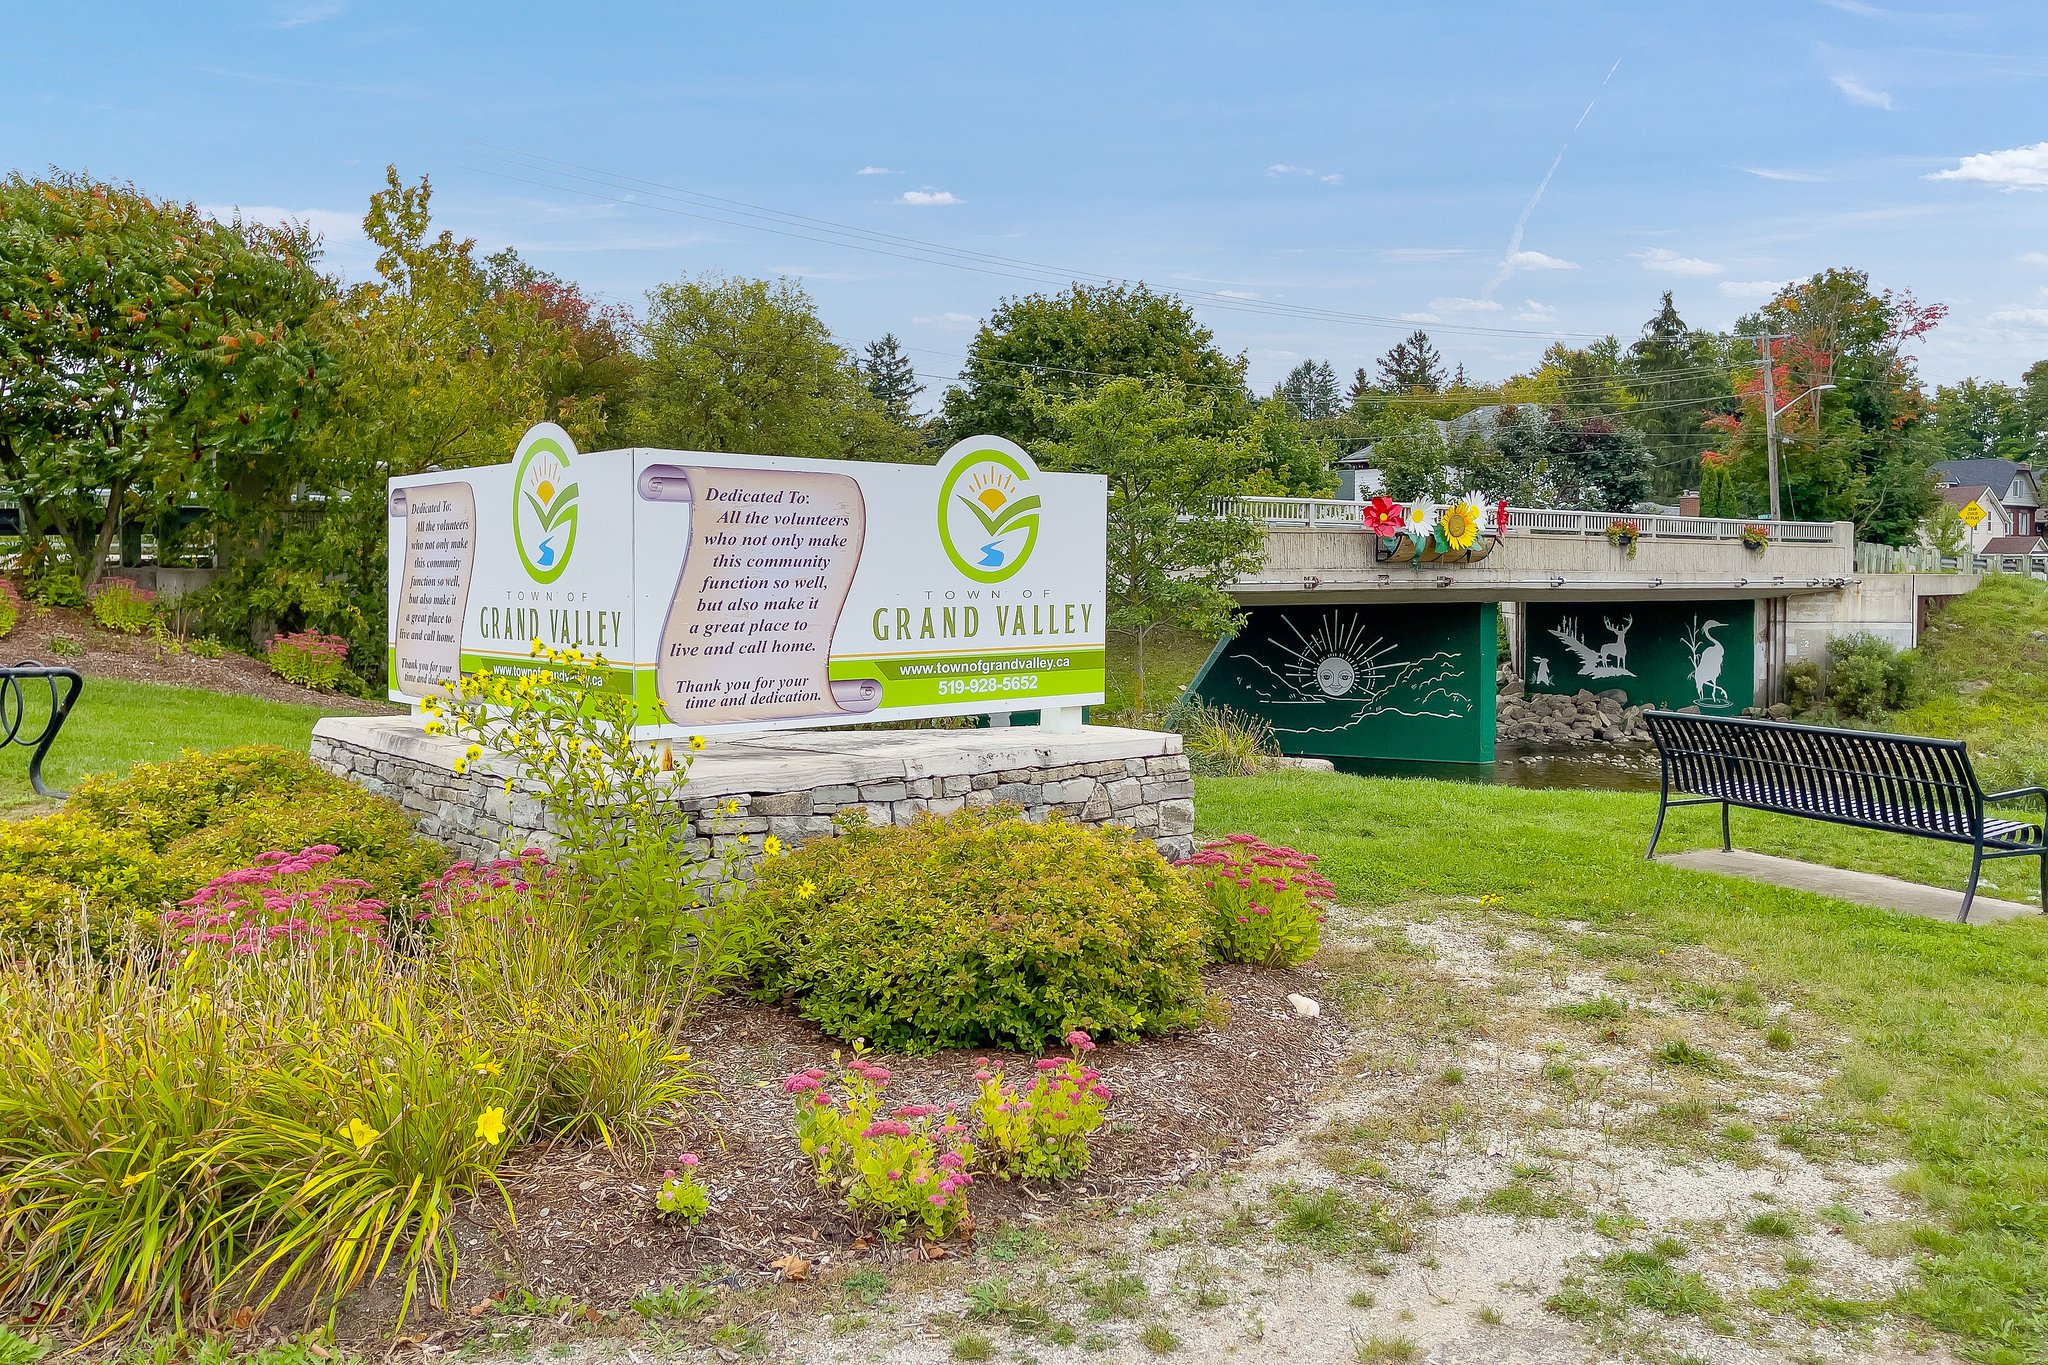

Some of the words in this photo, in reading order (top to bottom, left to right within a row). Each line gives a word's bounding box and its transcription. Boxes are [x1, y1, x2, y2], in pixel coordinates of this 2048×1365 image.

[705, 487, 782, 504] Dedicated
[788, 491, 810, 504] To:
[411, 501, 441, 515] Dedicated
[443, 500, 452, 512] To:
[416, 520, 425, 532] All
[426, 520, 436, 532] the
[437, 519, 469, 531] volunteers
[716, 510, 740, 524] All
[745, 511, 769, 525] the
[774, 512, 850, 527] volunteers
[411, 539, 424, 551] who
[425, 540, 436, 550] not
[436, 538, 450, 552] only
[451, 537, 469, 549] make
[704, 533, 737, 546] who
[742, 535, 767, 547] not
[771, 533, 804, 550] only
[808, 533, 847, 548] make
[414, 557, 425, 568] this
[427, 556, 461, 571] community
[713, 554, 742, 568] this
[746, 555, 831, 571] community
[409, 575, 436, 589] function
[437, 578, 444, 587] so
[446, 575, 460, 588] well,
[699, 576, 769, 593] function
[773, 579, 790, 590] so
[795, 576, 828, 591] well,
[408, 593, 419, 605] but
[420, 593, 432, 605] also
[433, 594, 450, 606] make
[451, 594, 457, 606] it
[506, 591, 553, 601] TOWN
[567, 592, 587, 602] OF
[925, 590, 1000, 600] TOWN
[1022, 589, 1050, 599] OF
[697, 598, 722, 612] but
[727, 597, 759, 611] also
[763, 596, 804, 610] make
[809, 597, 819, 610] it
[405, 614, 410, 622] a
[411, 614, 427, 625] great
[427, 612, 445, 626] place
[445, 614, 452, 624] to
[480, 606, 539, 641] GRAND
[550, 609, 621, 648] VALLEY
[872, 606, 979, 641] GRAND
[996, 604, 1092, 637] VALLEY
[399, 628, 410, 640] live
[411, 629, 423, 641] and
[423, 630, 436, 642] call
[436, 630, 456, 643] home.
[689, 623, 699, 634] a
[703, 621, 745, 637] great
[748, 620, 790, 636] place
[794, 620, 808, 631] to
[670, 643, 699, 657] live
[704, 641, 734, 656] and
[739, 640, 767, 654] call
[772, 640, 816, 653] home.
[1804, 640, 1810, 648] 2
[401, 658, 418, 670] Thank
[418, 662, 429, 673] you
[429, 660, 438, 674] for
[438, 664, 452, 675] your
[900, 657, 1070, 676] www.townofgrandvalley.ca
[404, 672, 416, 683] time
[416, 673, 427, 684] and
[676, 679, 722, 694] Thank
[724, 680, 750, 695] you
[752, 676, 776, 693] for
[777, 676, 809, 692] your
[938, 675, 1038, 696] 519-928-5652
[685, 695, 717, 710] time
[720, 692, 746, 707] and
[750, 690, 822, 706] dedication.
